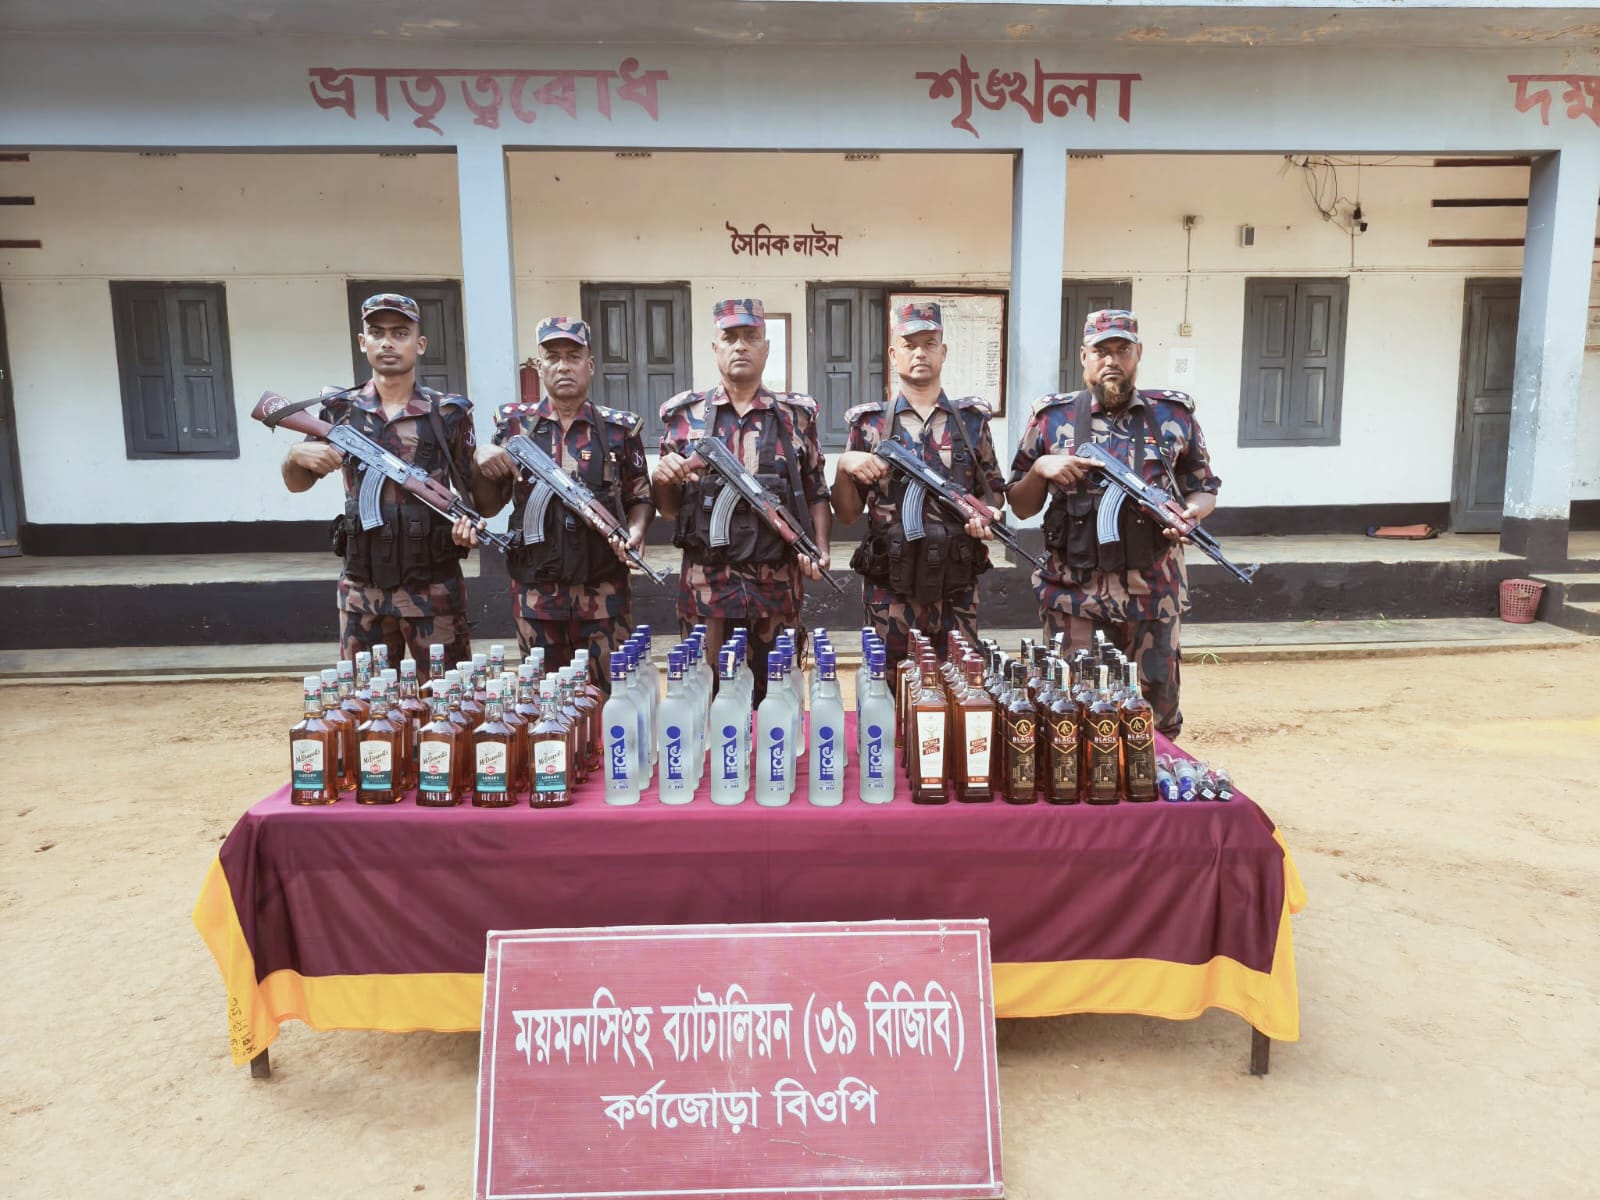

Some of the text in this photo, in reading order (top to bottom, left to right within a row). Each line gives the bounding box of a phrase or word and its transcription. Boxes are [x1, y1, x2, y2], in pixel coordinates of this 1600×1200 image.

[915, 53, 1143, 139] শৃঙ্খলা
[725, 220, 843, 257] সৈনিক লাইন
[511, 980, 965, 1074] ময়মনসিংহ ব্যাটালিয়ন (৩৯ বিজিবি)
[600, 1076, 880, 1134] কর্ণজোড়া বিওপি
